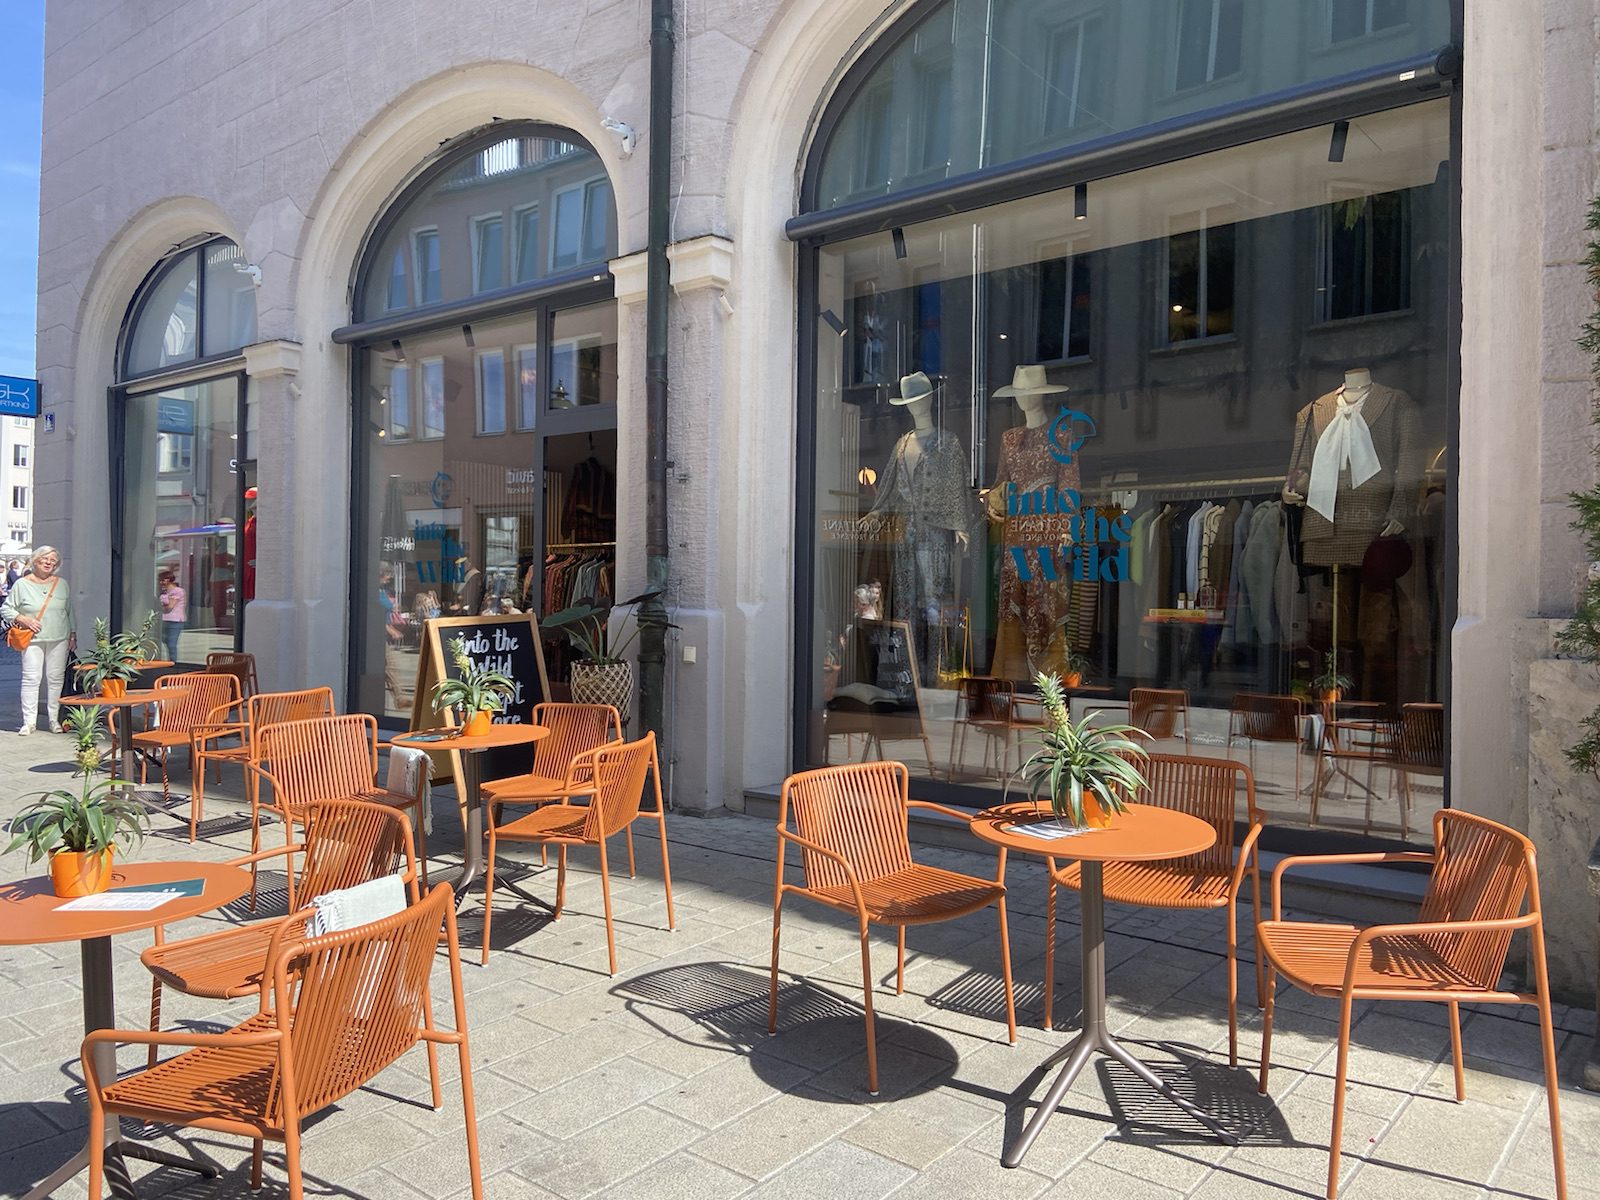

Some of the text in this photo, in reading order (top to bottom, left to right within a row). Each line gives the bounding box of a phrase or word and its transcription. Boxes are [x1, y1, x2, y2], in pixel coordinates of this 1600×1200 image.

[1007, 482, 1081, 516] into
[1070, 508, 1133, 543] the
[1010, 544, 1130, 582] Wild
[492, 628, 519, 652] the
[469, 654, 513, 679] Wild
